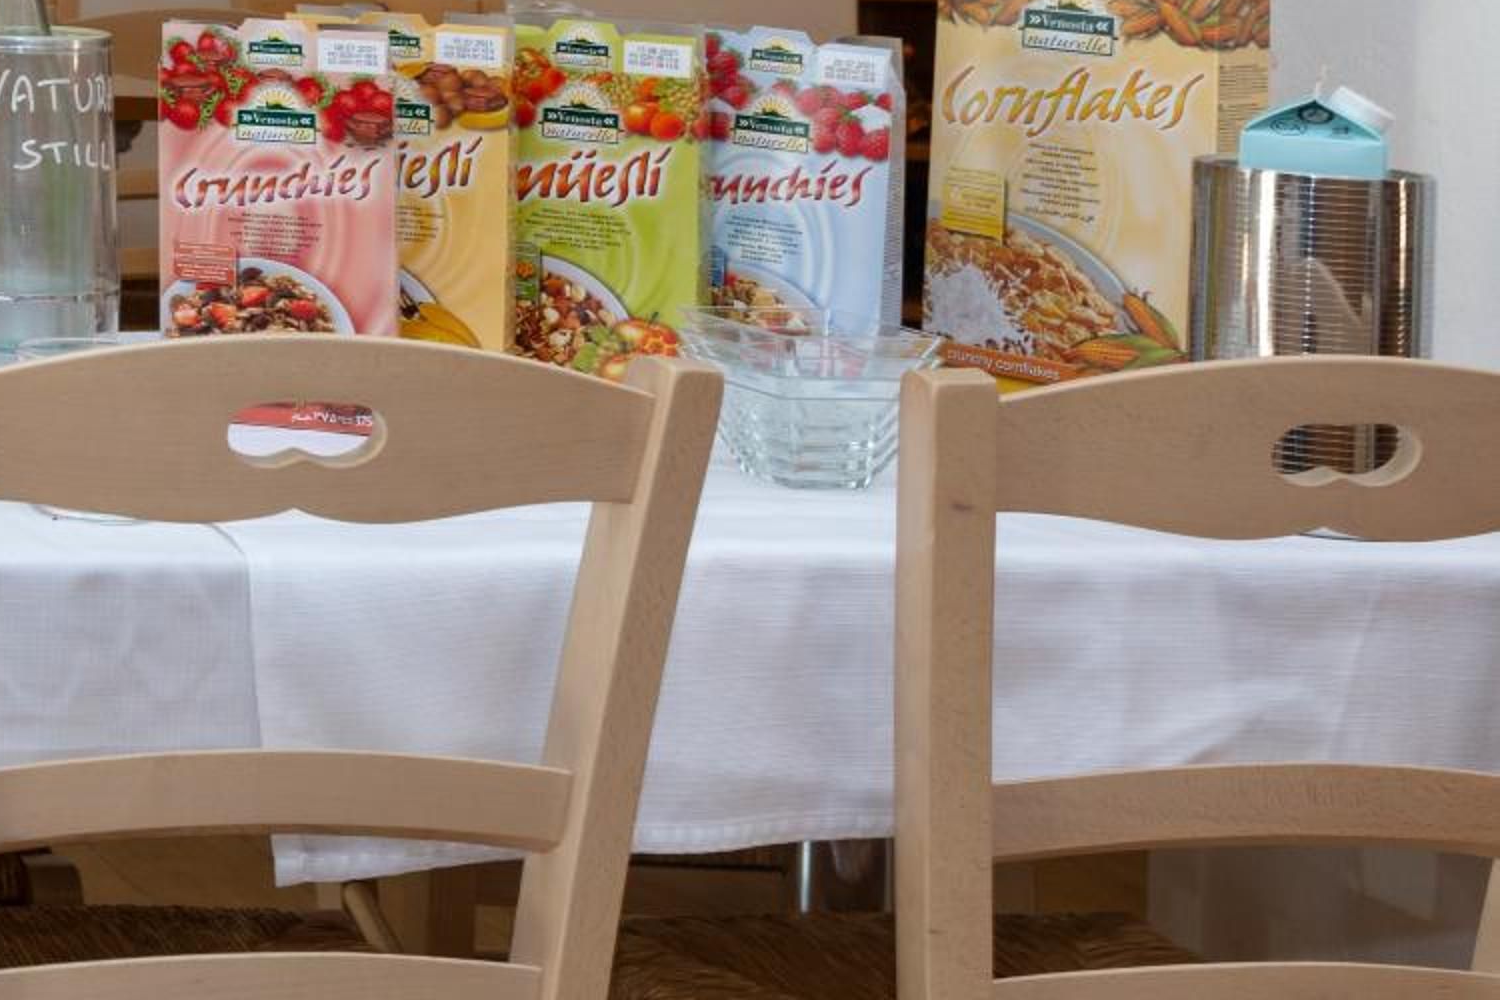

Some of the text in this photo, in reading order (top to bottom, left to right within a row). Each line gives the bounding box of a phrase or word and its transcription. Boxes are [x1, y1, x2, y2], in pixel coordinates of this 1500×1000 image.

[1041, 16, 1094, 32] Venosta
[1026, 34, 1108, 51] naturelle
[941, 65, 1204, 137] Cornflakes
[254, 113, 298, 127] Venosta
[558, 112, 601, 125] Venosta
[545, 125, 616, 140] naturelle
[750, 121, 793, 135] Venosta
[737, 134, 805, 150] naturelle
[13, 139, 112, 170] STILL
[174, 155, 380, 208] Crunchies
[710, 160, 873, 207] unchies
